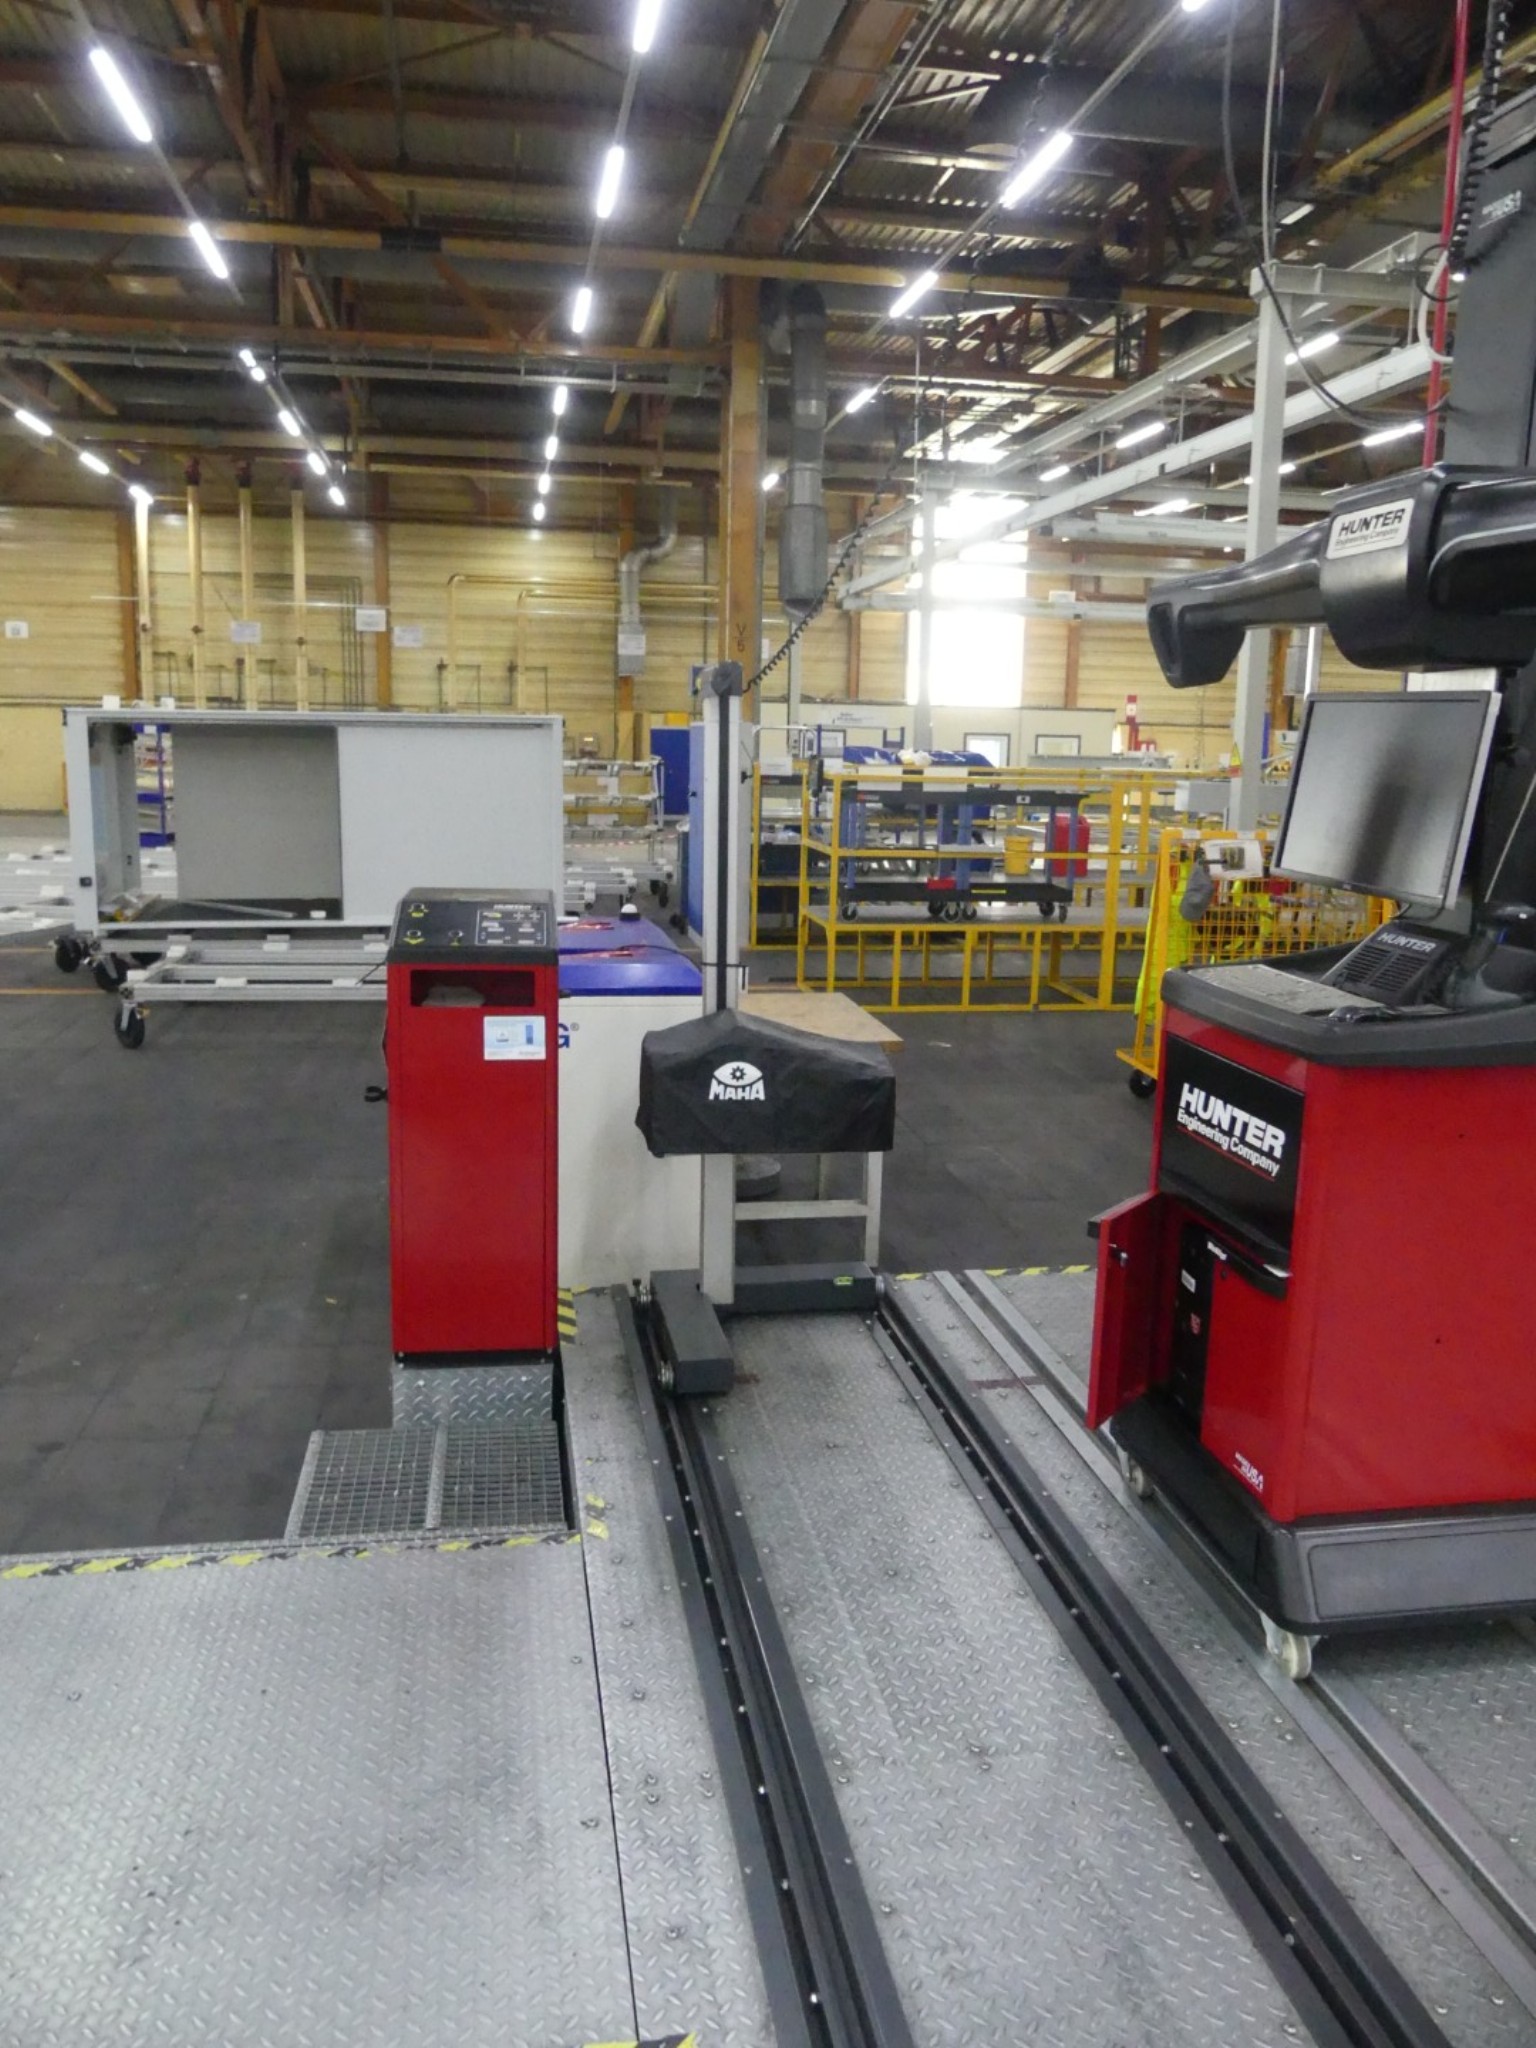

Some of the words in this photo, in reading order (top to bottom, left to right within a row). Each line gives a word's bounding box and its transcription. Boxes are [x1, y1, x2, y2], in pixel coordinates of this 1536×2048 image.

[1338, 508, 1405, 537] HUNTER
[1378, 932, 1437, 953] HUNTER
[708, 1077, 766, 1101] MAHA
[1180, 1082, 1286, 1159] HUNTER
[1177, 1107, 1230, 1151] Engineering
[1229, 1137, 1280, 1177] Company
